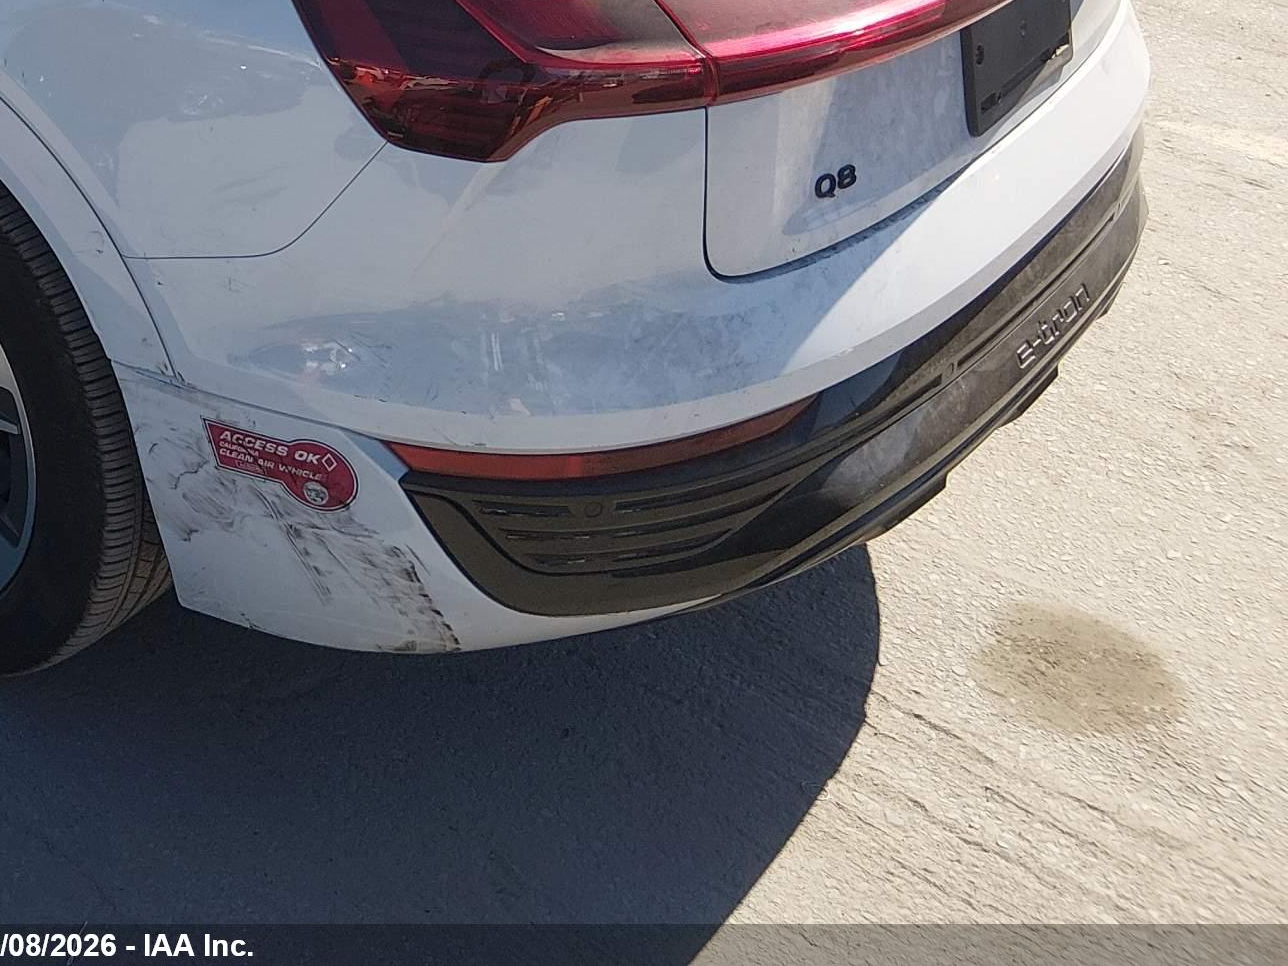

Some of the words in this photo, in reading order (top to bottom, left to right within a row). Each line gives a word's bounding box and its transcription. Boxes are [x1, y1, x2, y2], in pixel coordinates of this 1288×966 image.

[814, 164, 857, 198] Q8
[1016, 282, 1090, 368] e-tron
[219, 448, 253, 463] CLEAN
[220, 430, 289, 457] ACCESS
[294, 450, 321, 465] OK
